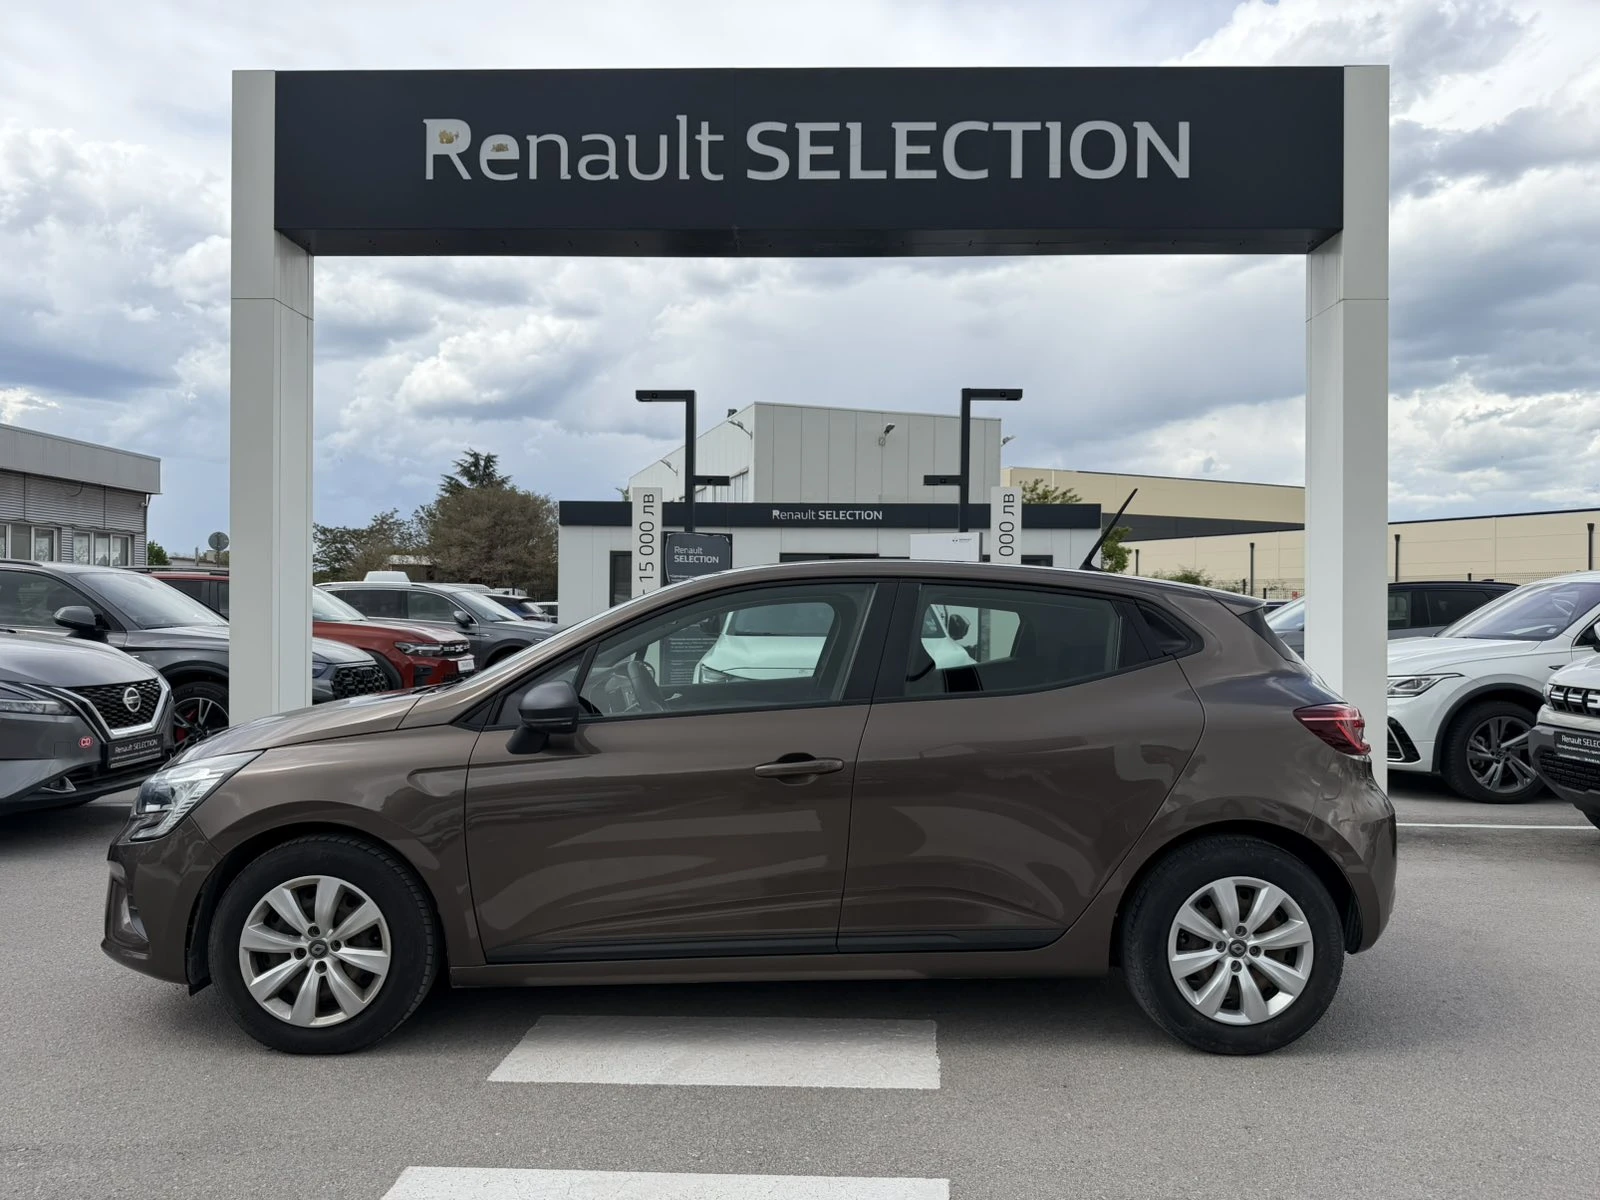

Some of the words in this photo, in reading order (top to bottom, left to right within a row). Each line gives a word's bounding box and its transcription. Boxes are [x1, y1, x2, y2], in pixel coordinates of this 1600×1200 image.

[422, 114, 724, 181] Renault
[746, 120, 1190, 181] SELECTION
[772, 509, 816, 520] Renault
[818, 510, 883, 520] SELECTION
[639, 521, 655, 556] 000
[998, 521, 1015, 557] 000
[674, 545, 703, 554] Renault
[674, 555, 719, 563] SELECTION
[639, 562, 654, 582] 15
[114, 744, 133, 753] Renault
[133, 739, 158, 751] SELECTION
[1561, 735, 1582, 745] Renault
